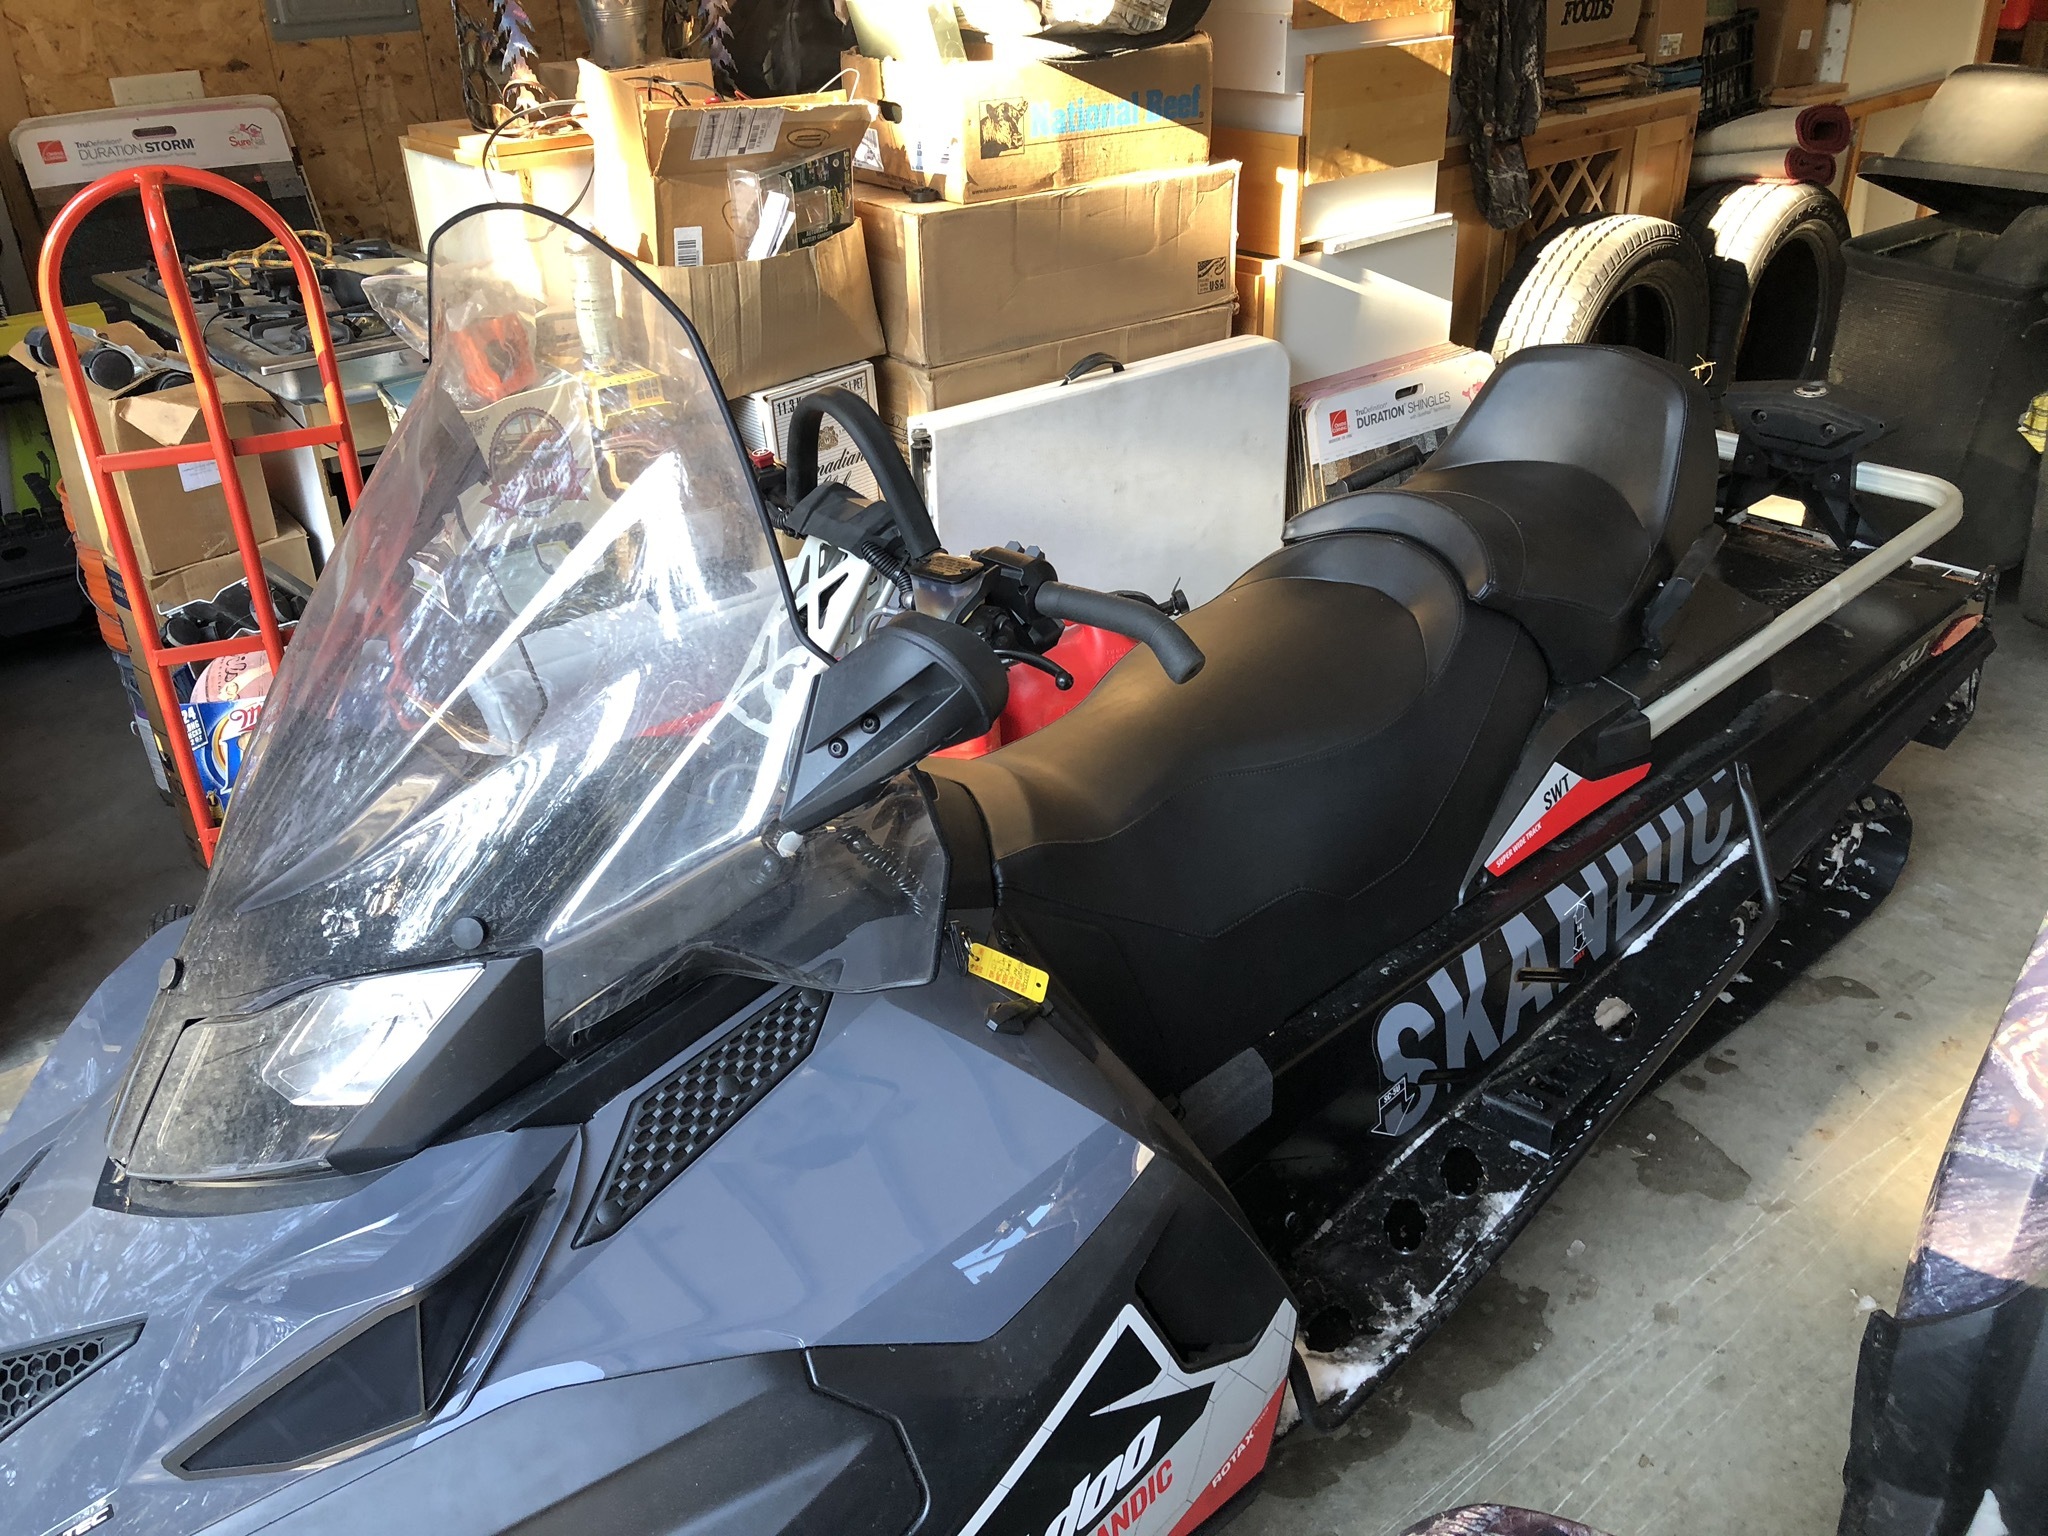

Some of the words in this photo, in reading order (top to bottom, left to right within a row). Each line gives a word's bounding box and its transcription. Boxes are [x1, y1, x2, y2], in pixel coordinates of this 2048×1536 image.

[1560, 0, 1614, 25] FOODS
[1029, 91, 1139, 138] National
[1145, 84, 1201, 123] Beef
[78, 143, 144, 161] DURATION
[146, 138, 195, 153] STORM
[1209, 279, 1225, 291] USA
[777, 399, 795, 416] 11.3
[1356, 406, 1405, 429] DURATION
[1407, 391, 1451, 413] SHINGLES
[181, 706, 197, 725] 24
[1543, 773, 1570, 811] SWT
[1495, 851, 1513, 869] SUPER
[1512, 837, 1527, 857] WIDE
[1526, 821, 1543, 841] TRACK
[1376, 768, 1733, 1137] SKANDIC
[1211, 1429, 1255, 1489] ROTAX
